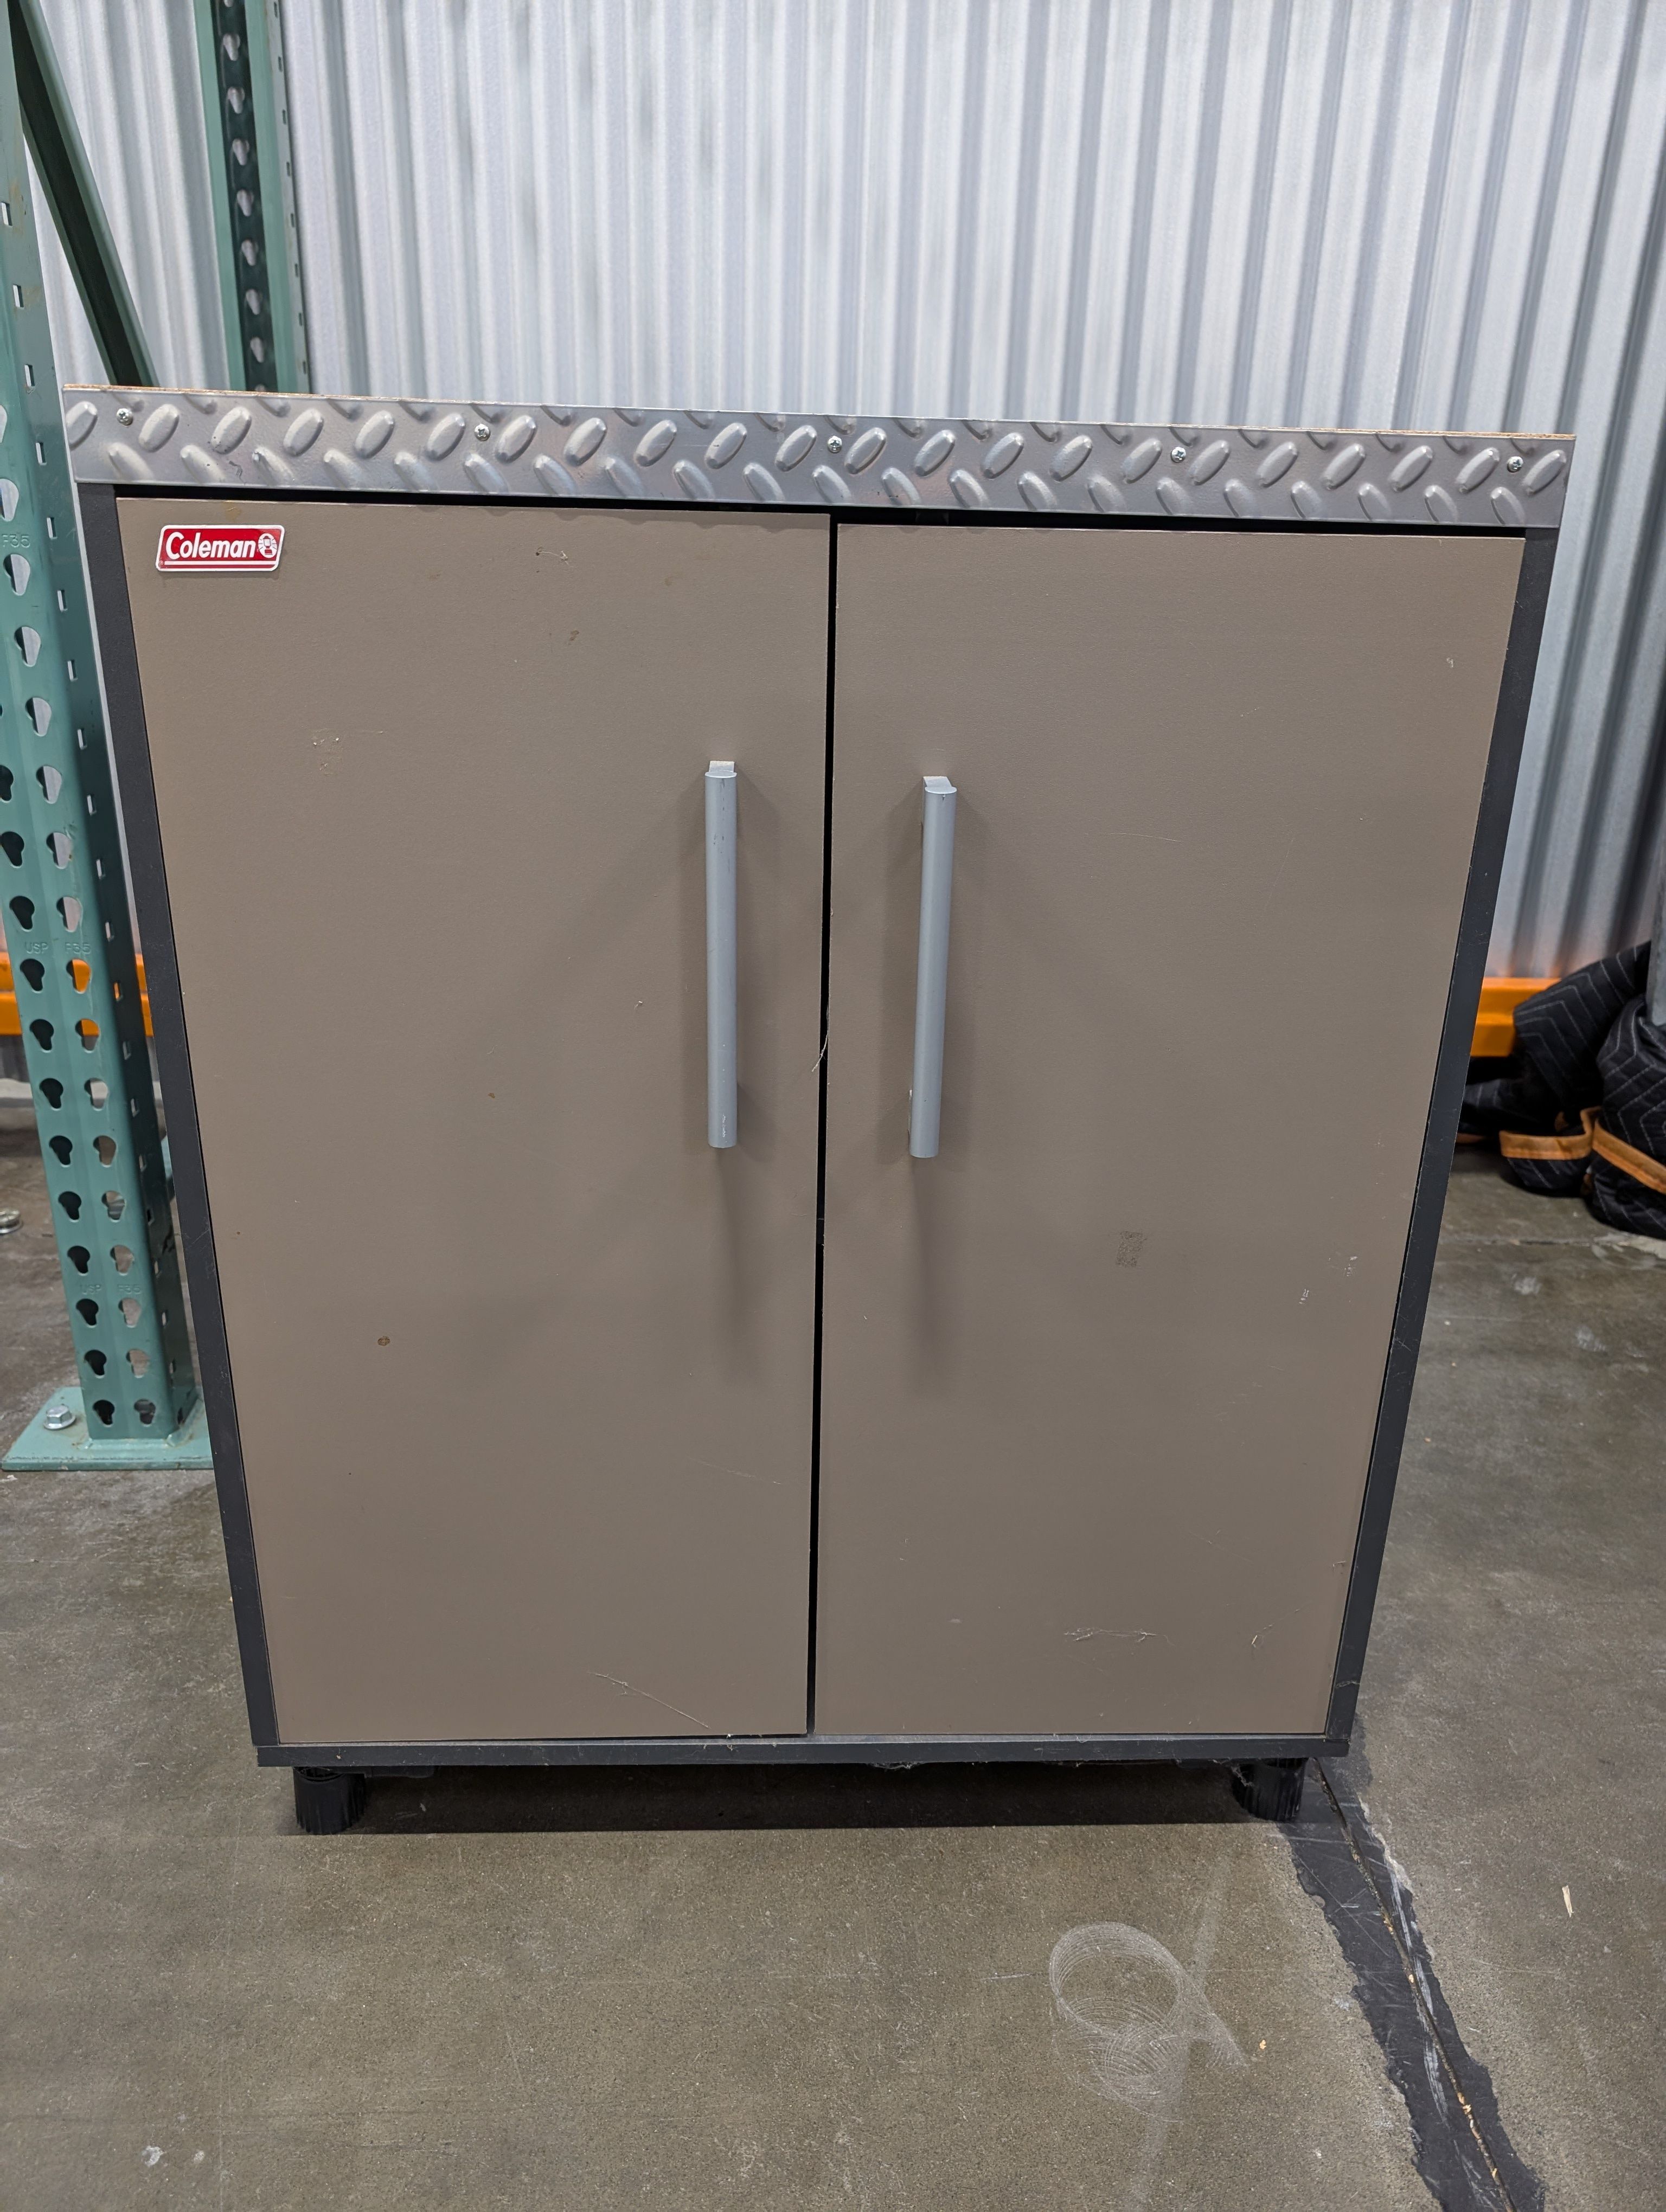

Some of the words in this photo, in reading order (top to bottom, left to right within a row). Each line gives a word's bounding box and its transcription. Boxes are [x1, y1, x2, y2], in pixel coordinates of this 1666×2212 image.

[2, 534, 32, 550] F35
[165, 531, 257, 560] Coleman
[25, 942, 49, 954] USP
